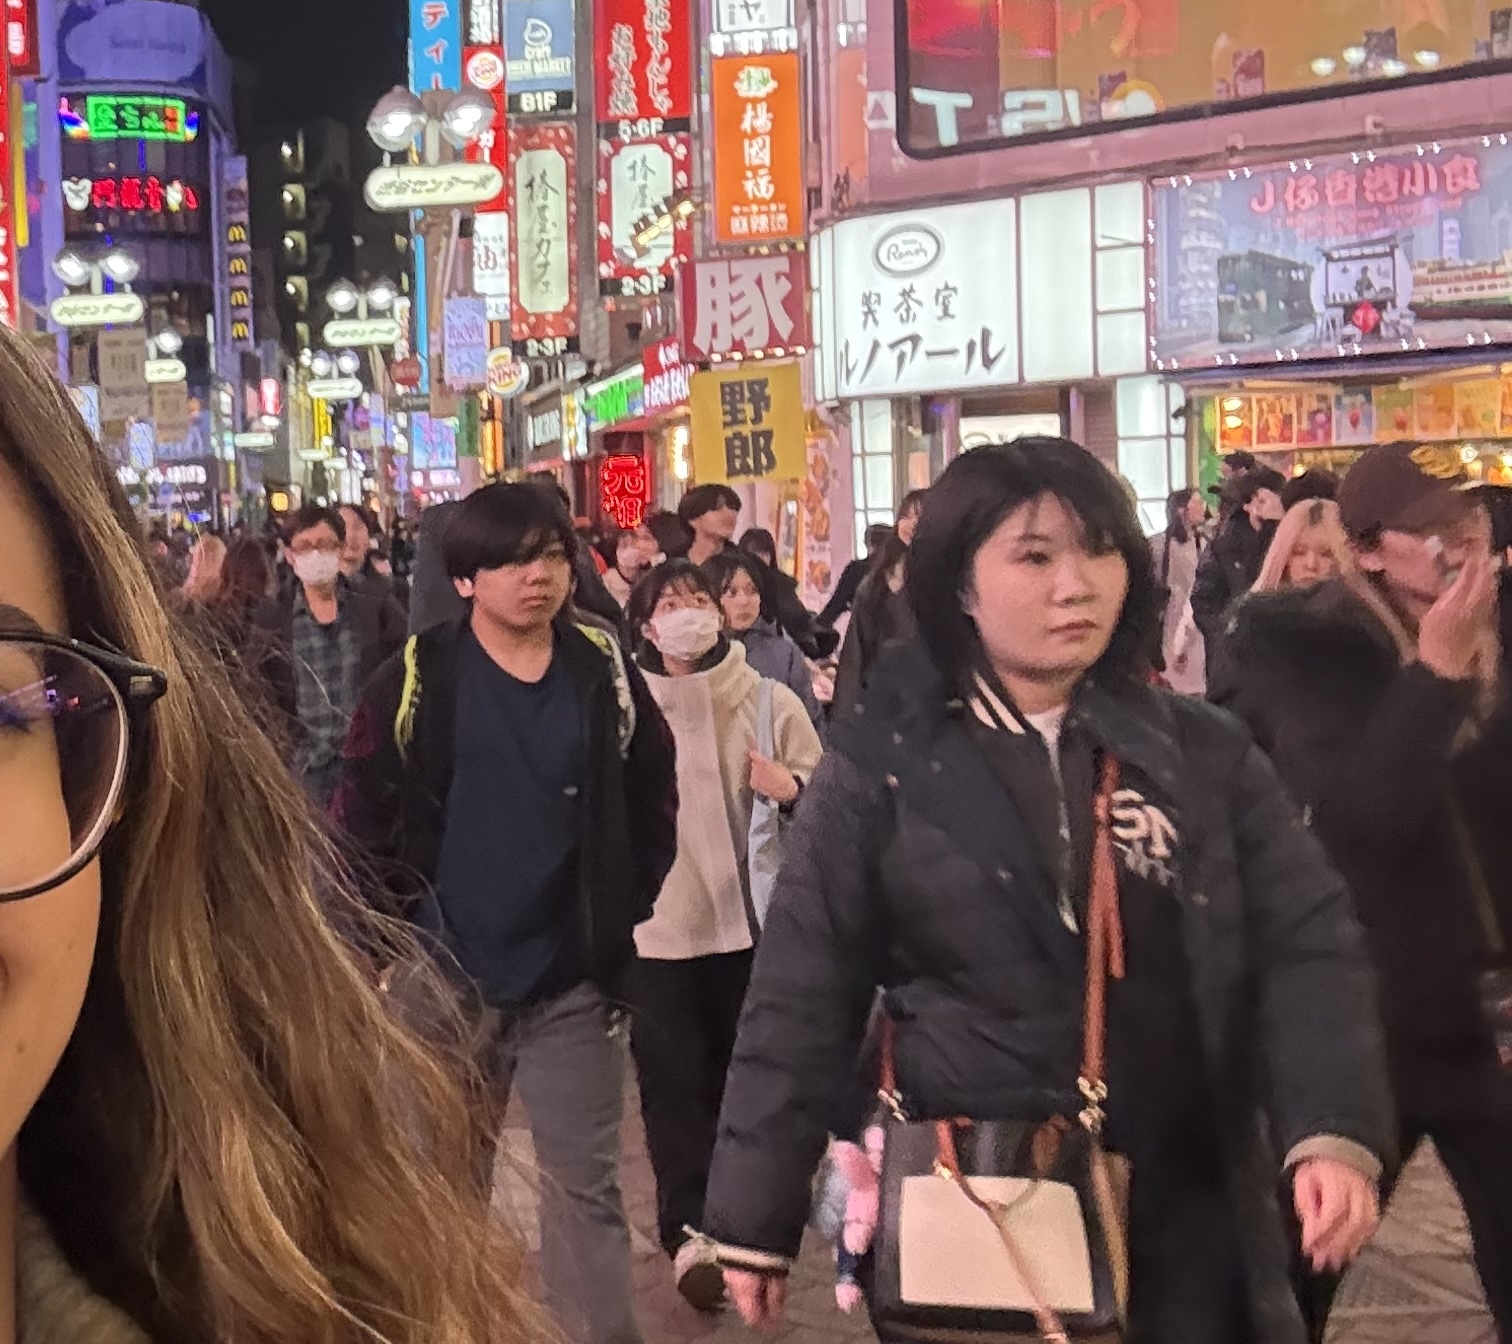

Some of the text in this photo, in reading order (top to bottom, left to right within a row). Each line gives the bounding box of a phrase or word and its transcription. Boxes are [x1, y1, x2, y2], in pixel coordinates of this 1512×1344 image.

[693, 256, 795, 355] 豚
[860, 280, 958, 331] 喫茶室
[839, 323, 1006, 387] ルノアール
[720, 377, 777, 481] 野郎
